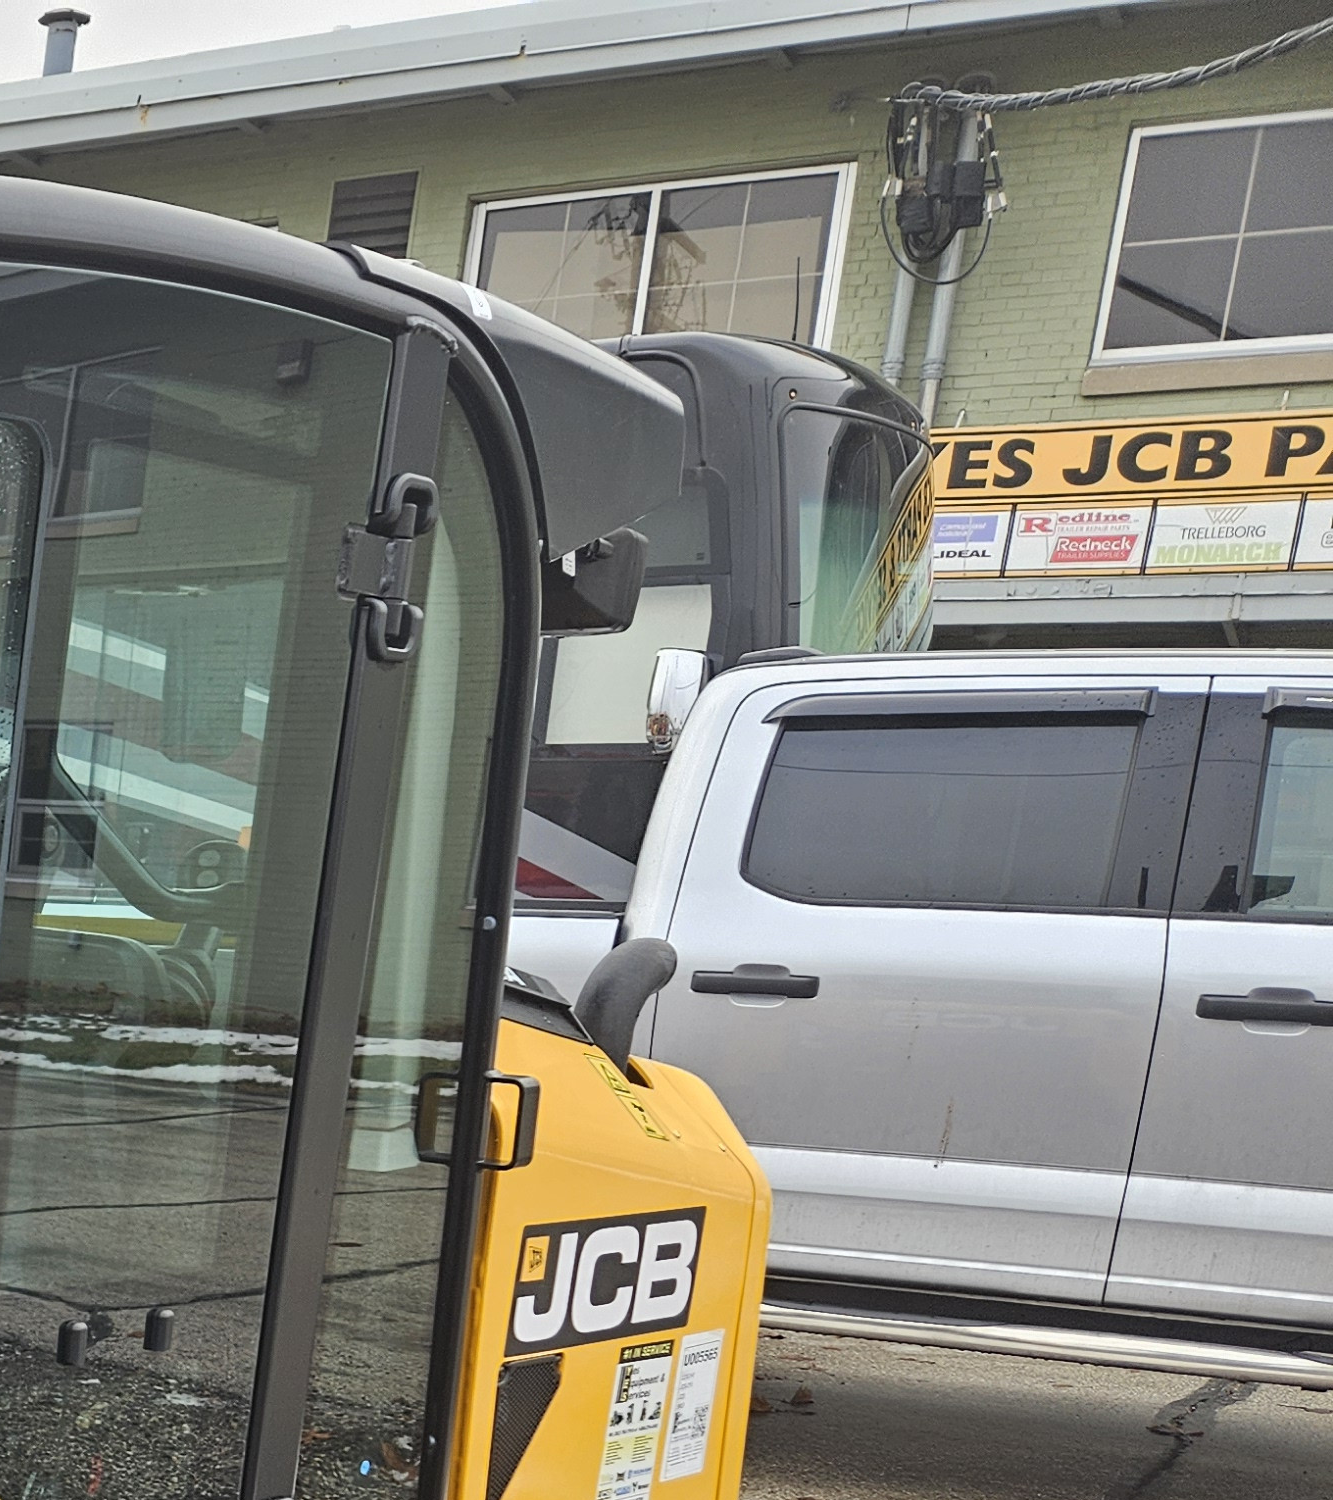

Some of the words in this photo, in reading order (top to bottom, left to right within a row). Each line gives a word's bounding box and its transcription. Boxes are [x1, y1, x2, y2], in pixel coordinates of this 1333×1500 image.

[1062, 429, 1233, 486] JCB
[1181, 525, 1267, 541] TRELLEBORG
[1056, 537, 1131, 551] Redneck
[934, 549, 991, 559] IDEAL
[1057, 551, 1084, 559] TRAILER
[1153, 541, 1284, 565] MONARCH
[513, 1219, 698, 1343] JCB
